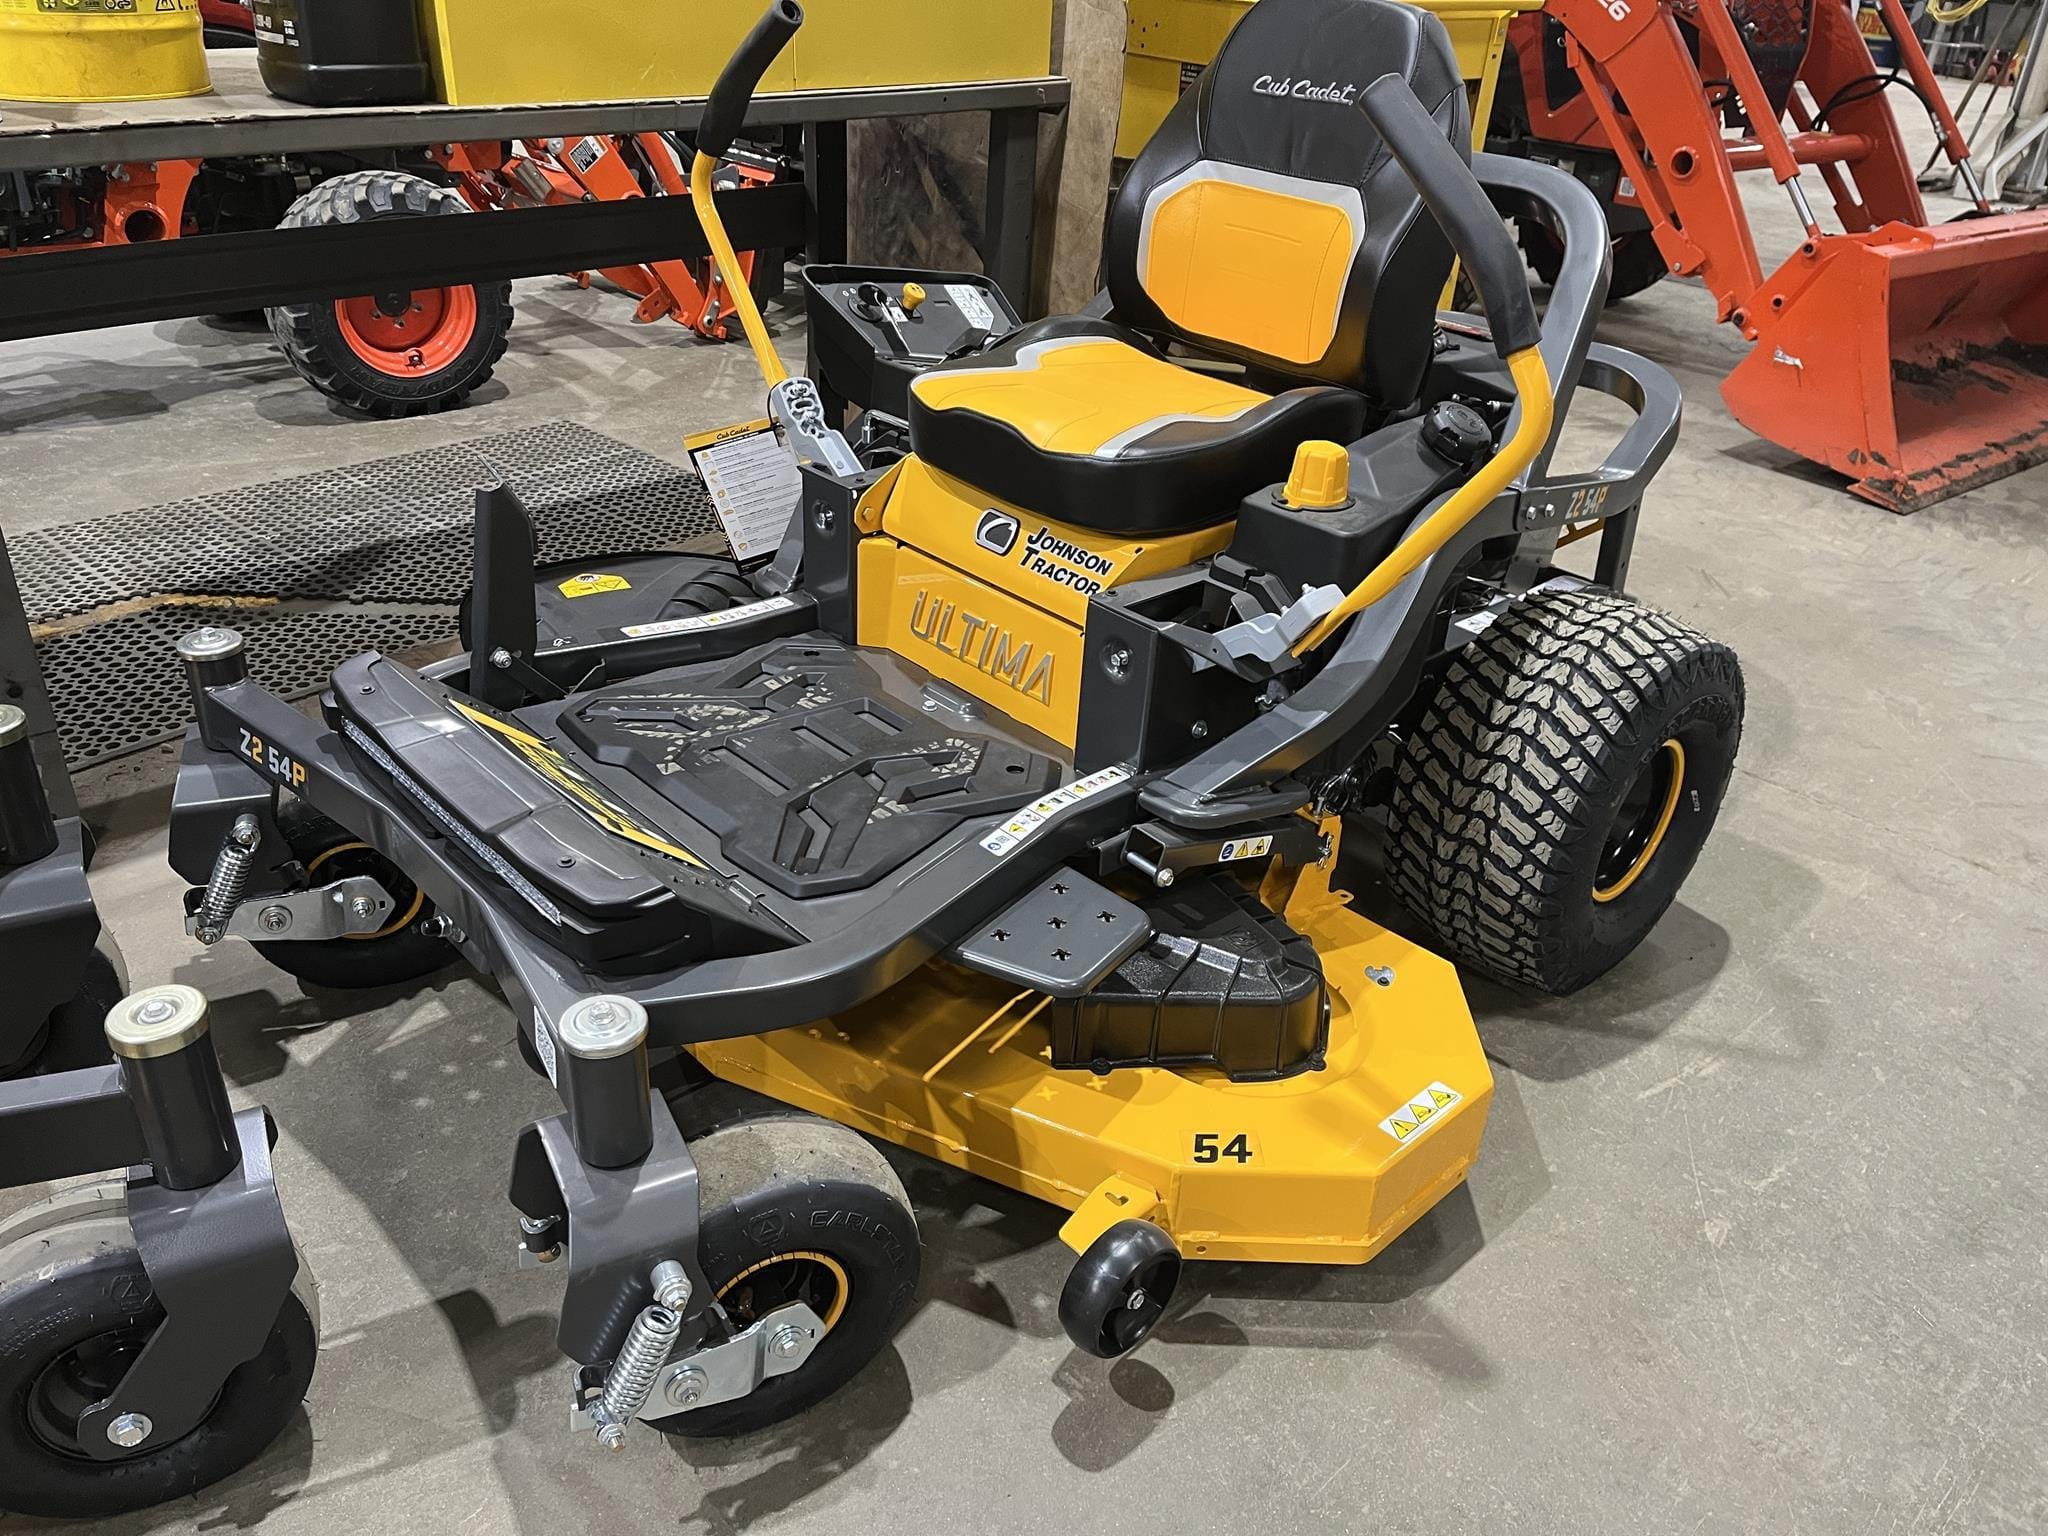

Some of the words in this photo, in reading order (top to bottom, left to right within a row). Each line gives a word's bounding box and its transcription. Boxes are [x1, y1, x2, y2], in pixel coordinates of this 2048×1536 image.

[1252, 75, 1291, 97] Cub
[1291, 80, 1356, 104] Cadet
[1020, 546, 1101, 597] TRACTOR
[1027, 526, 1113, 576] JOHNSON
[911, 588, 1055, 707] ULTIMA
[240, 727, 263, 764] Z2
[268, 745, 306, 787] 54P
[1193, 1133, 1254, 1164] 54
